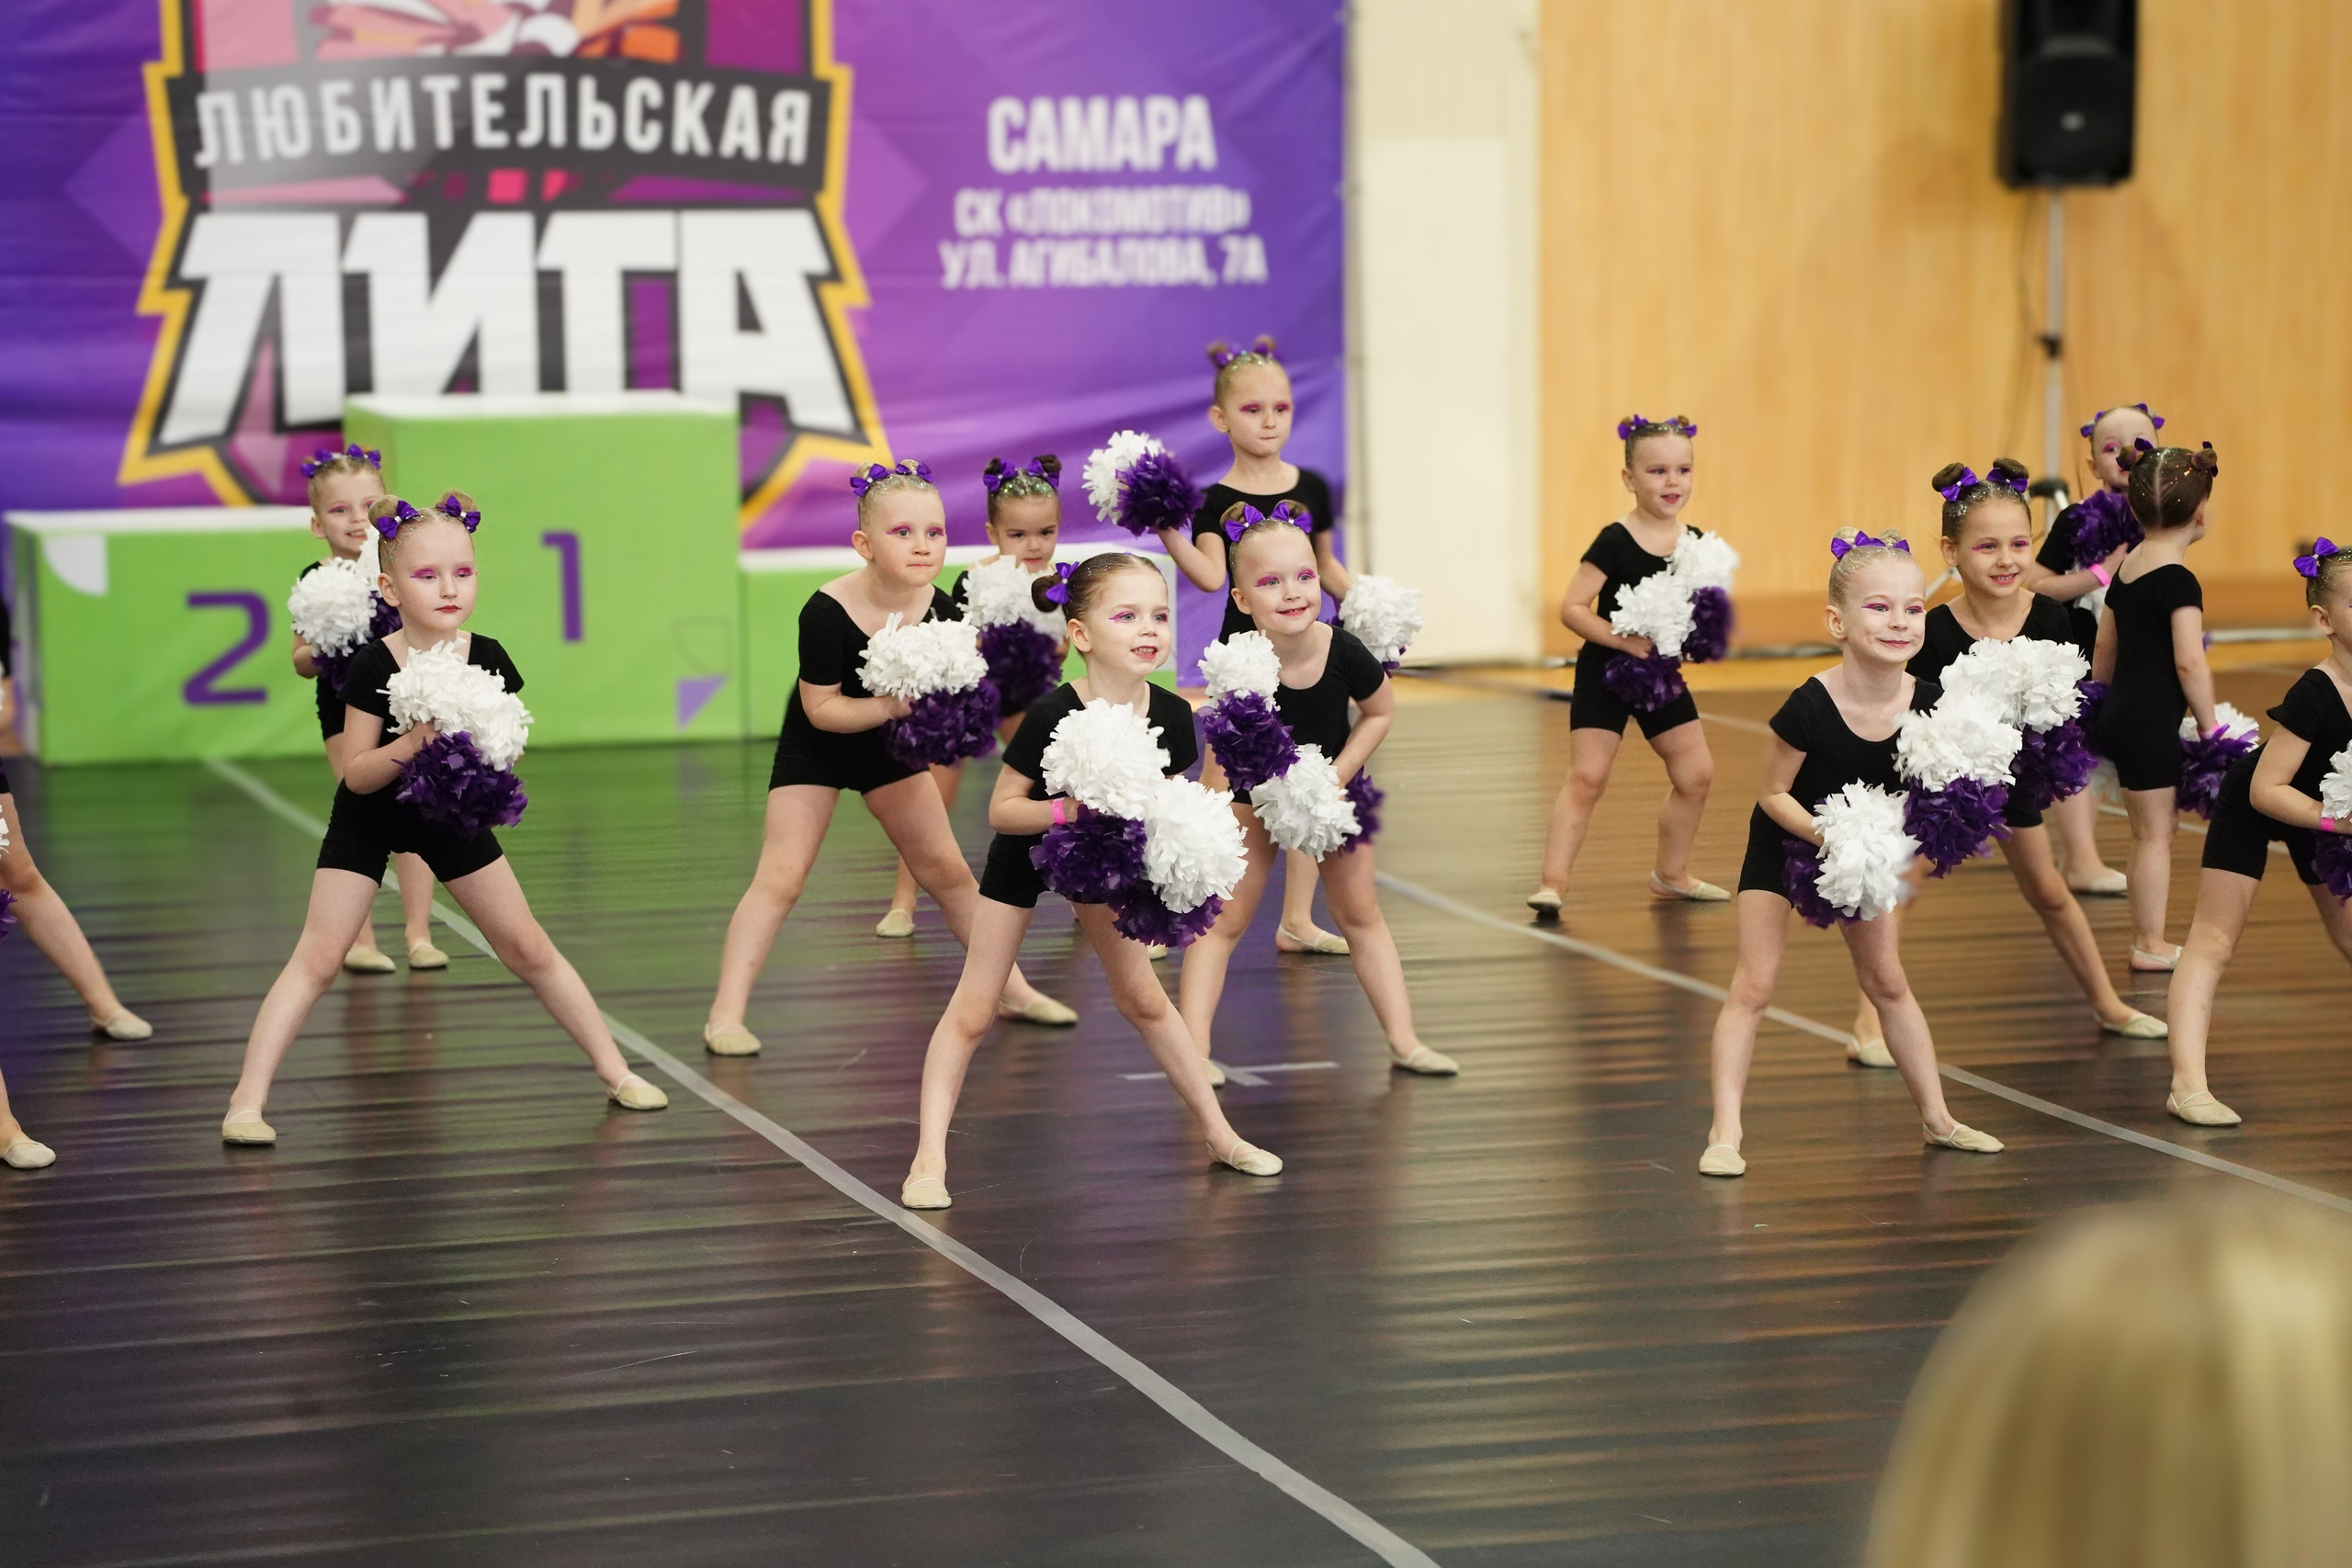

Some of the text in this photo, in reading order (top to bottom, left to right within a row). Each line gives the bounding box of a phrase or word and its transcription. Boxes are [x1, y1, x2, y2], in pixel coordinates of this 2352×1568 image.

[194, 73, 811, 166] ЛЮБИТЕЛЬСКАЯ
[988, 95, 1217, 173] САМАРА
[954, 187, 1004, 236] СК
[1220, 234, 1269, 285] 7А
[159, 210, 855, 445] ЛИГА
[542, 530, 584, 643] 1
[183, 591, 271, 706] 2
